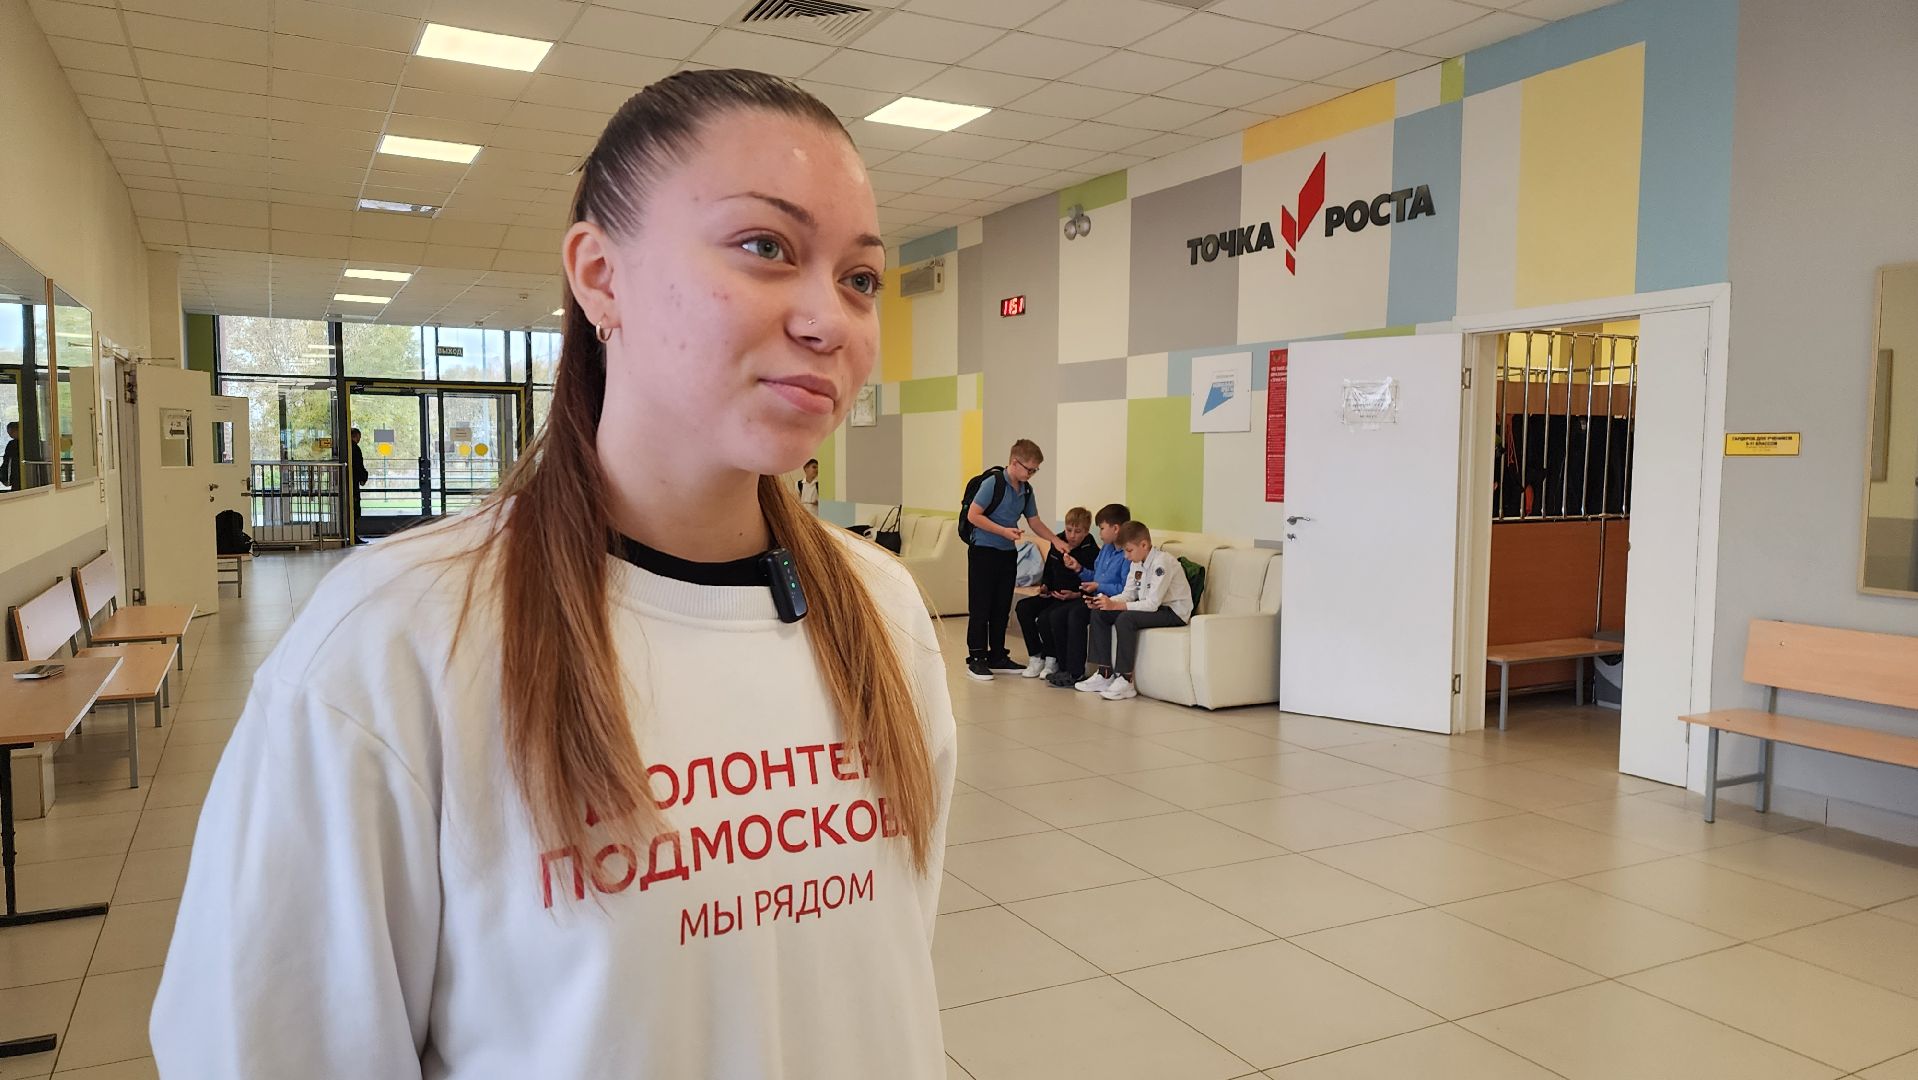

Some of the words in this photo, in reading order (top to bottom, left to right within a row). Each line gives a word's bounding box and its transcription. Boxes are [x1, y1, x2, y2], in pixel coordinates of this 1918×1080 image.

[1186, 221, 1275, 265] ТОЧКА
[1324, 184, 1436, 237] РОСТА
[585, 740, 884, 827] ОЛОНТЕ
[540, 797, 908, 908] ПОДМОСКОВ
[680, 896, 743, 946] МЫ
[755, 870, 875, 927] РЯДОМ
